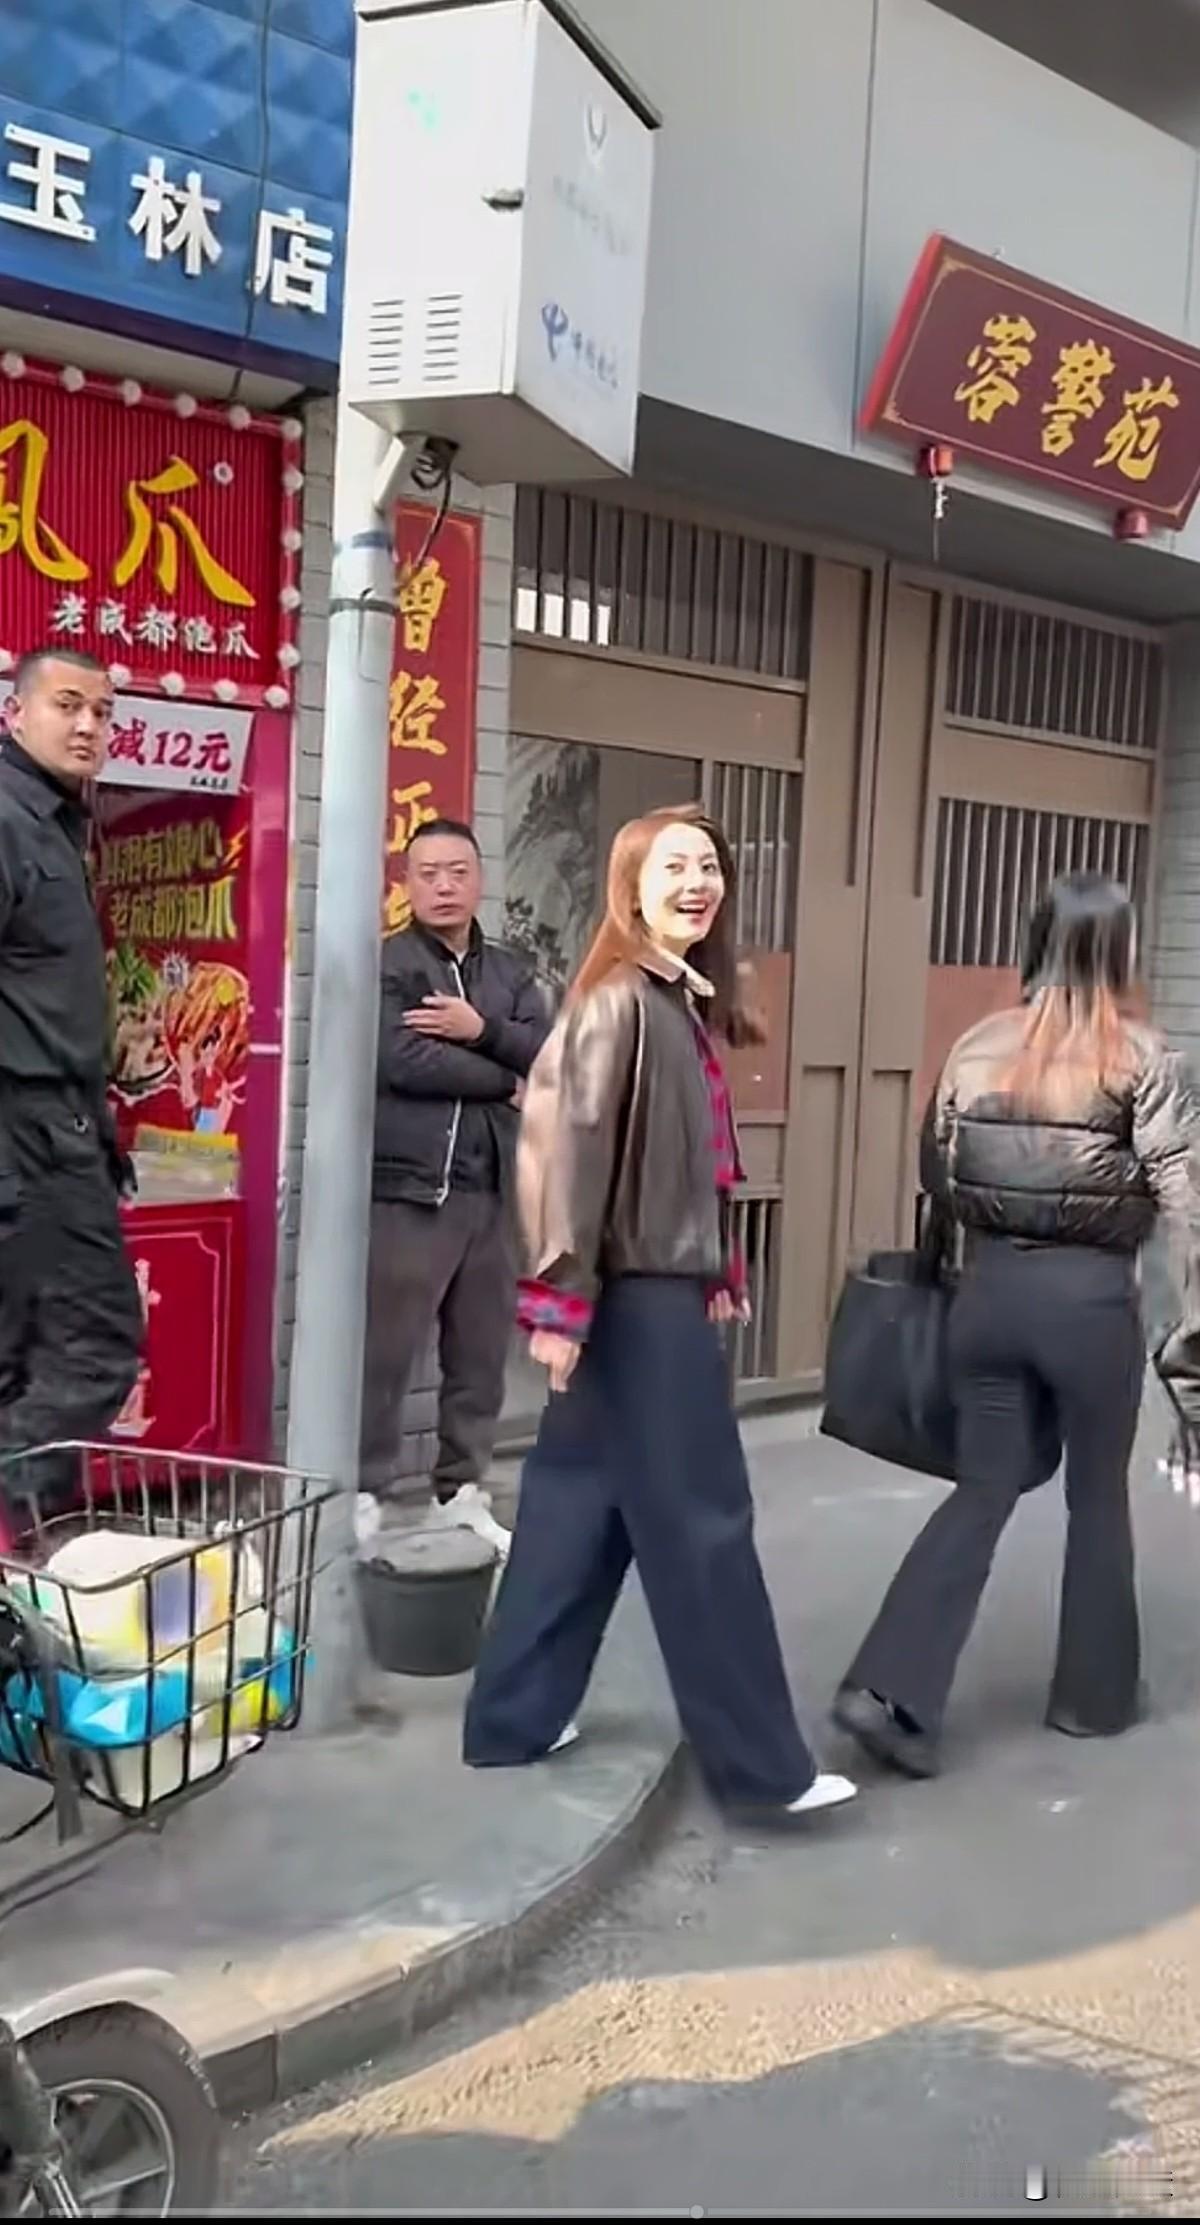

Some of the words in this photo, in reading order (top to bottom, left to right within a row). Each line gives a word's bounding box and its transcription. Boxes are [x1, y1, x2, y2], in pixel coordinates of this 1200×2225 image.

[0, 122, 334, 315] 玉林店
[954, 313, 1180, 482] 蓉警苑
